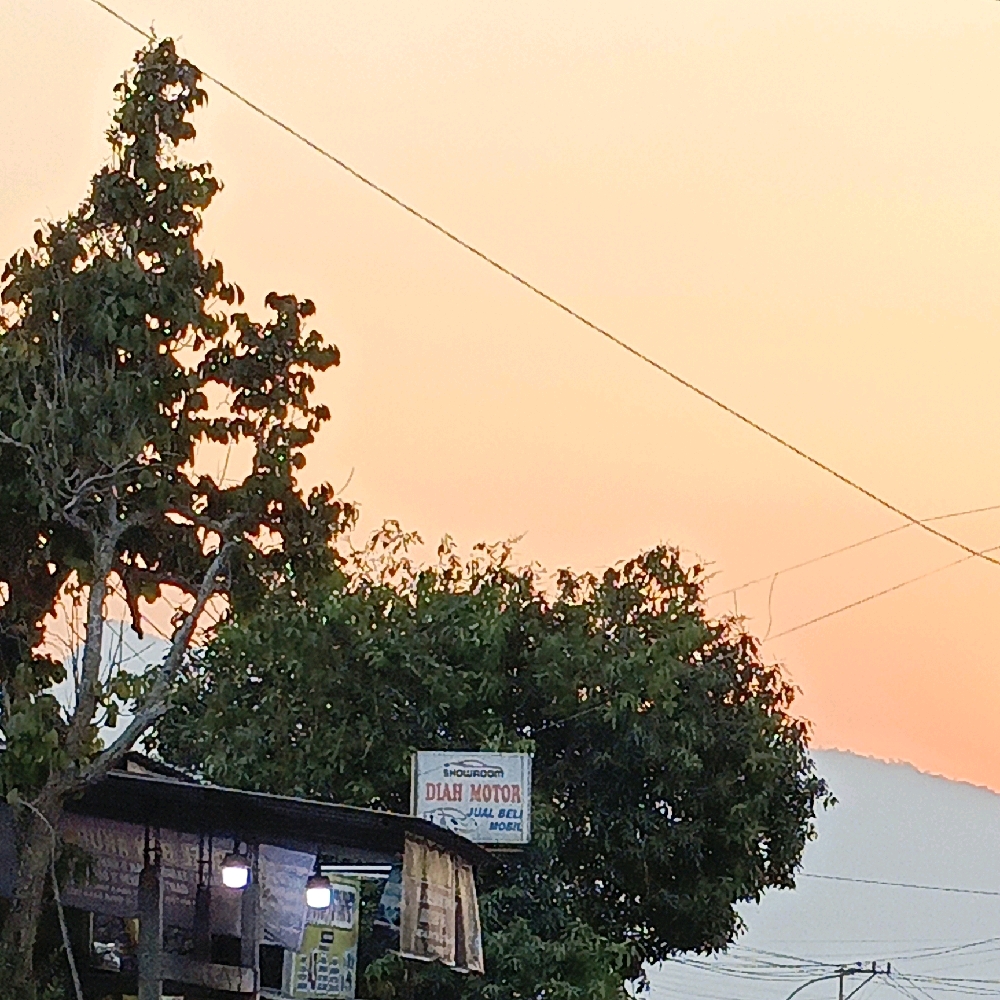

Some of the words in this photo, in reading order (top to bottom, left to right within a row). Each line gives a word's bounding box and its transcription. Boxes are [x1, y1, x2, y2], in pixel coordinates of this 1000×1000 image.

[443, 768, 504, 778] SHOWROOM
[425, 782, 463, 802] DIAH
[469, 784, 521, 803] MOTOR
[467, 807, 494, 818] JUAL
[498, 809, 523, 819] BELI
[489, 821, 522, 832] MOBIL
